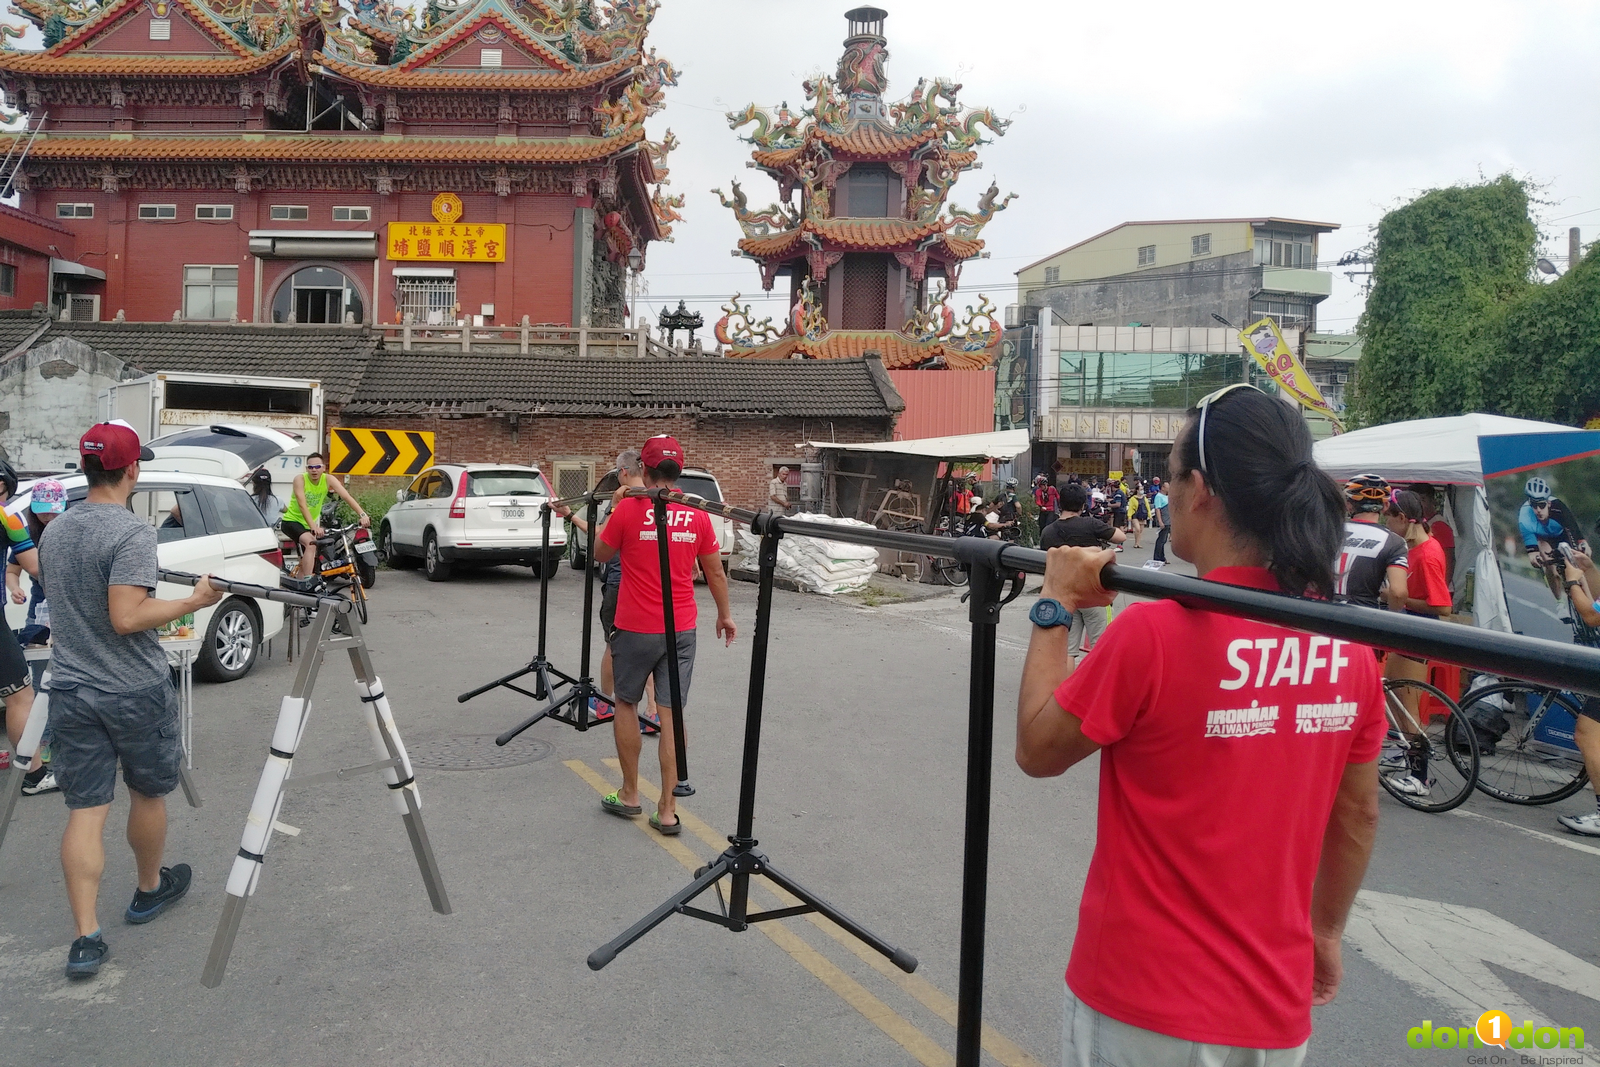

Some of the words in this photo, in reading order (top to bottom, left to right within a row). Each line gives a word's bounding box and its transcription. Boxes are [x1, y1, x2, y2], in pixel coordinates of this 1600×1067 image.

[408, 226, 485, 237] 北極玄天上帝
[393, 238, 500, 258] 埔鹽順澤宮
[643, 508, 695, 527] SAFF
[1219, 635, 1350, 690] STAFF
[1206, 700, 1280, 725] IRONMAN
[1295, 695, 1358, 719] IRONMAN
[1206, 723, 1250, 734] TAIWAN
[1251, 720, 1275, 729] PENGHU
[1295, 718, 1322, 734] 70.3
